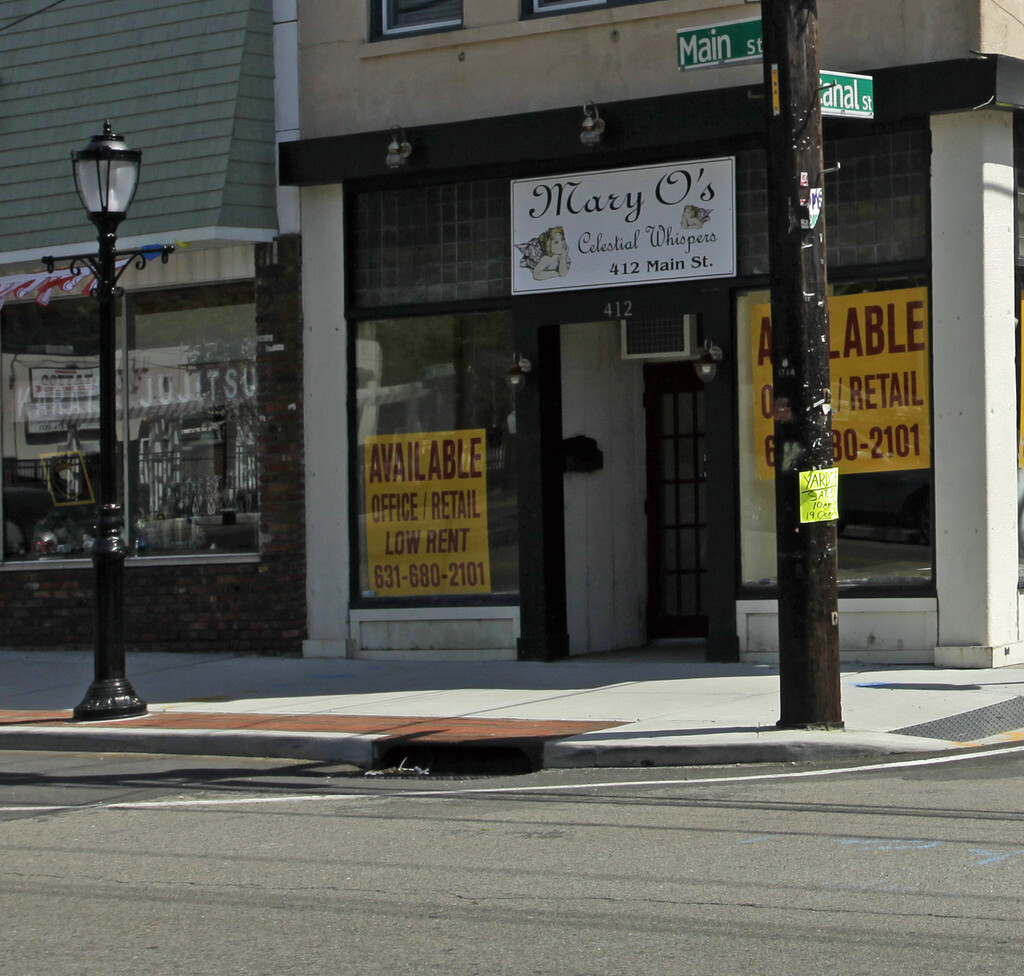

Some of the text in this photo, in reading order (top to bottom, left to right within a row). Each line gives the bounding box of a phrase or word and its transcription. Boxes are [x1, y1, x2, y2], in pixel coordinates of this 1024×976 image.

[679, 29, 732, 65] Main
[862, 95, 872, 111] St
[528, 168, 715, 223] Mary O's
[578, 225, 718, 254] Celestial Whispers
[610, 256, 714, 276] 412 Main St.
[604, 300, 632, 317] 412
[850, 370, 924, 412] RETAIL
[369, 438, 482, 484] AVAILABLE
[804, 471, 830, 490] YARD
[372, 492, 418, 523] OFFICE
[431, 490, 480, 520] RETAIL
[385, 528, 470, 555] LOW RENT
[374, 562, 485, 588] 631-680-2101
